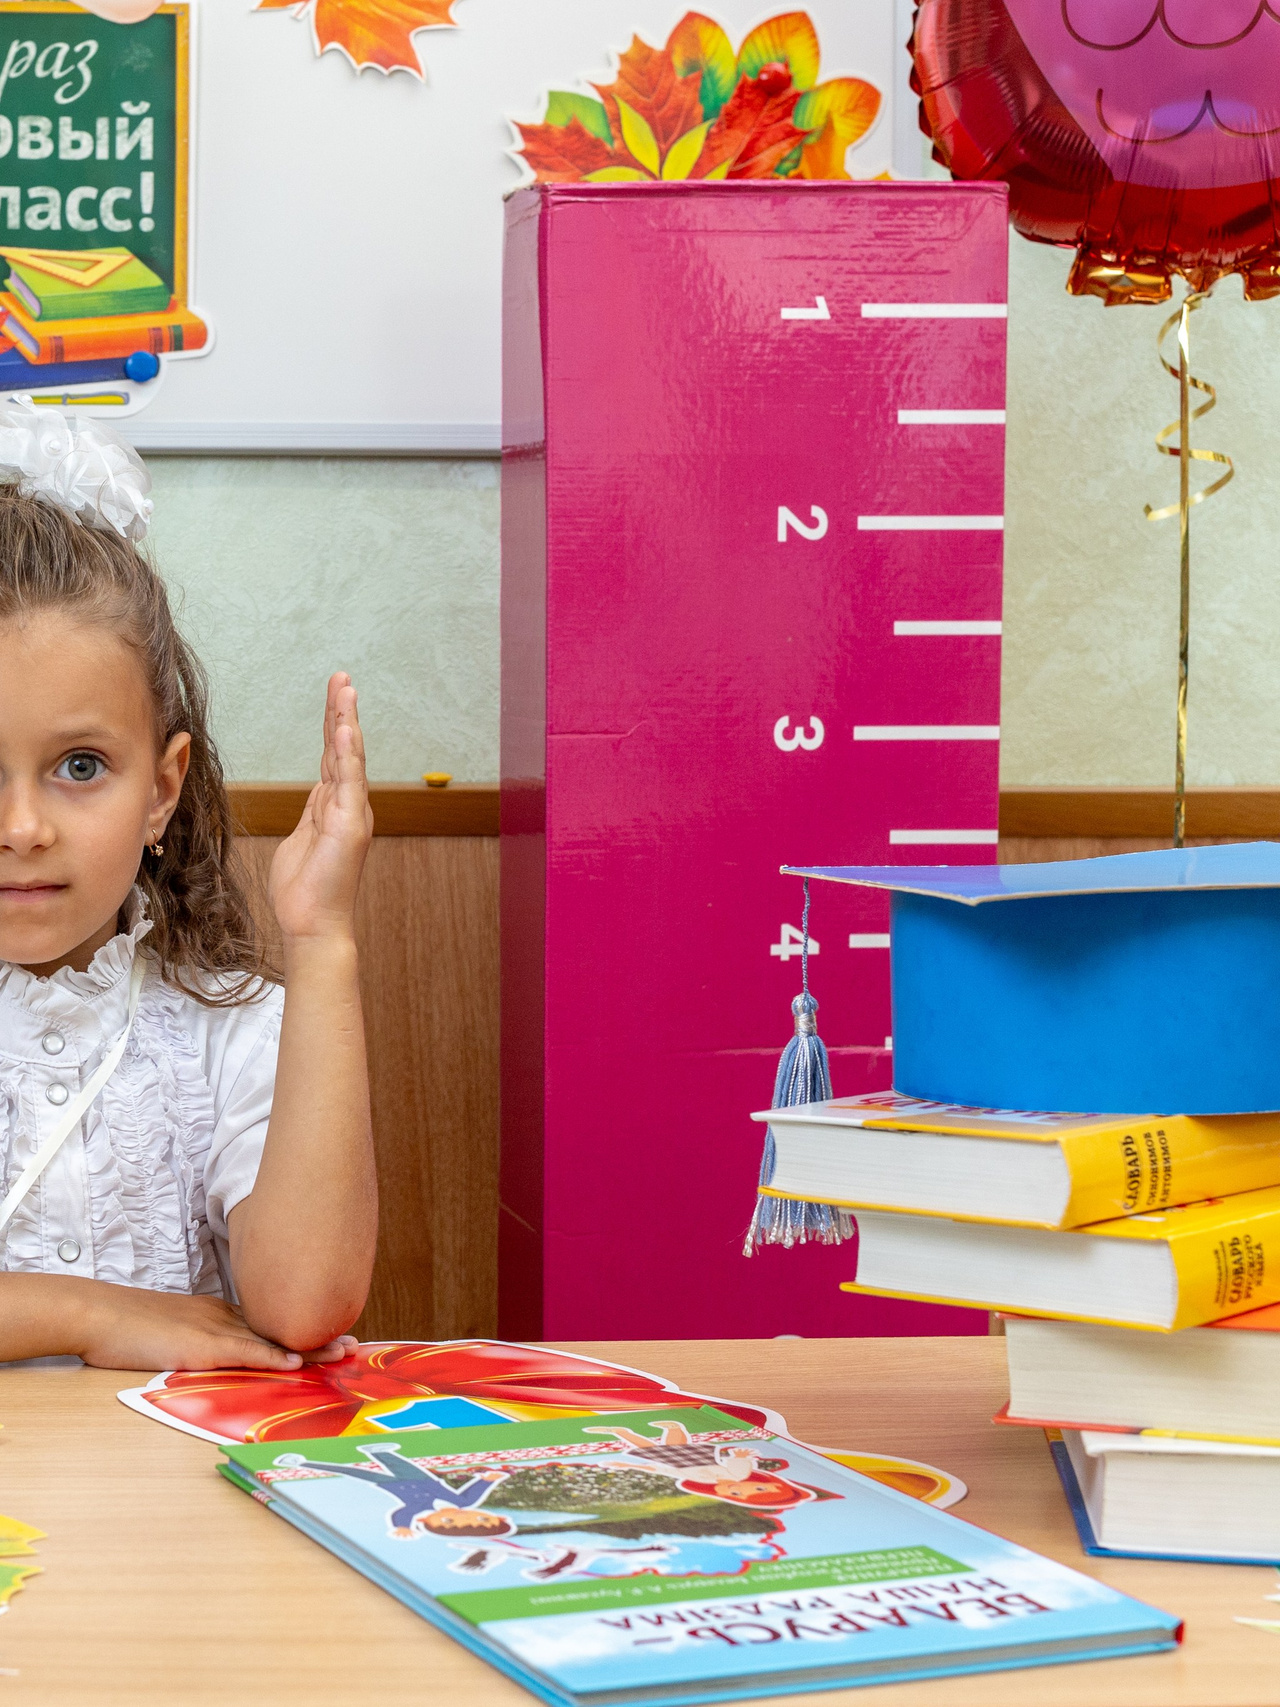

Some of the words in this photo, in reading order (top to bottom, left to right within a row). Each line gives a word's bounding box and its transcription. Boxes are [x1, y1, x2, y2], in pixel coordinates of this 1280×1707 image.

[780, 296, 832, 320] 1
[777, 505, 828, 542] 2
[773, 715, 824, 752] 3
[770, 923, 820, 961] 4
[1122, 1135, 1140, 1210] СЛОВАРЬ
[1143, 1131, 1158, 1206] СИНОНИМОВ
[1157, 1129, 1171, 1203] АНТОНИМОВ
[1228, 1236, 1244, 1304] СЛОВАРЬ
[844, 1577, 1008, 1604] НАША
[596, 1596, 835, 1631] РАДЗІМА
[686, 1592, 1053, 1647] БЕЛАРУСЬ
